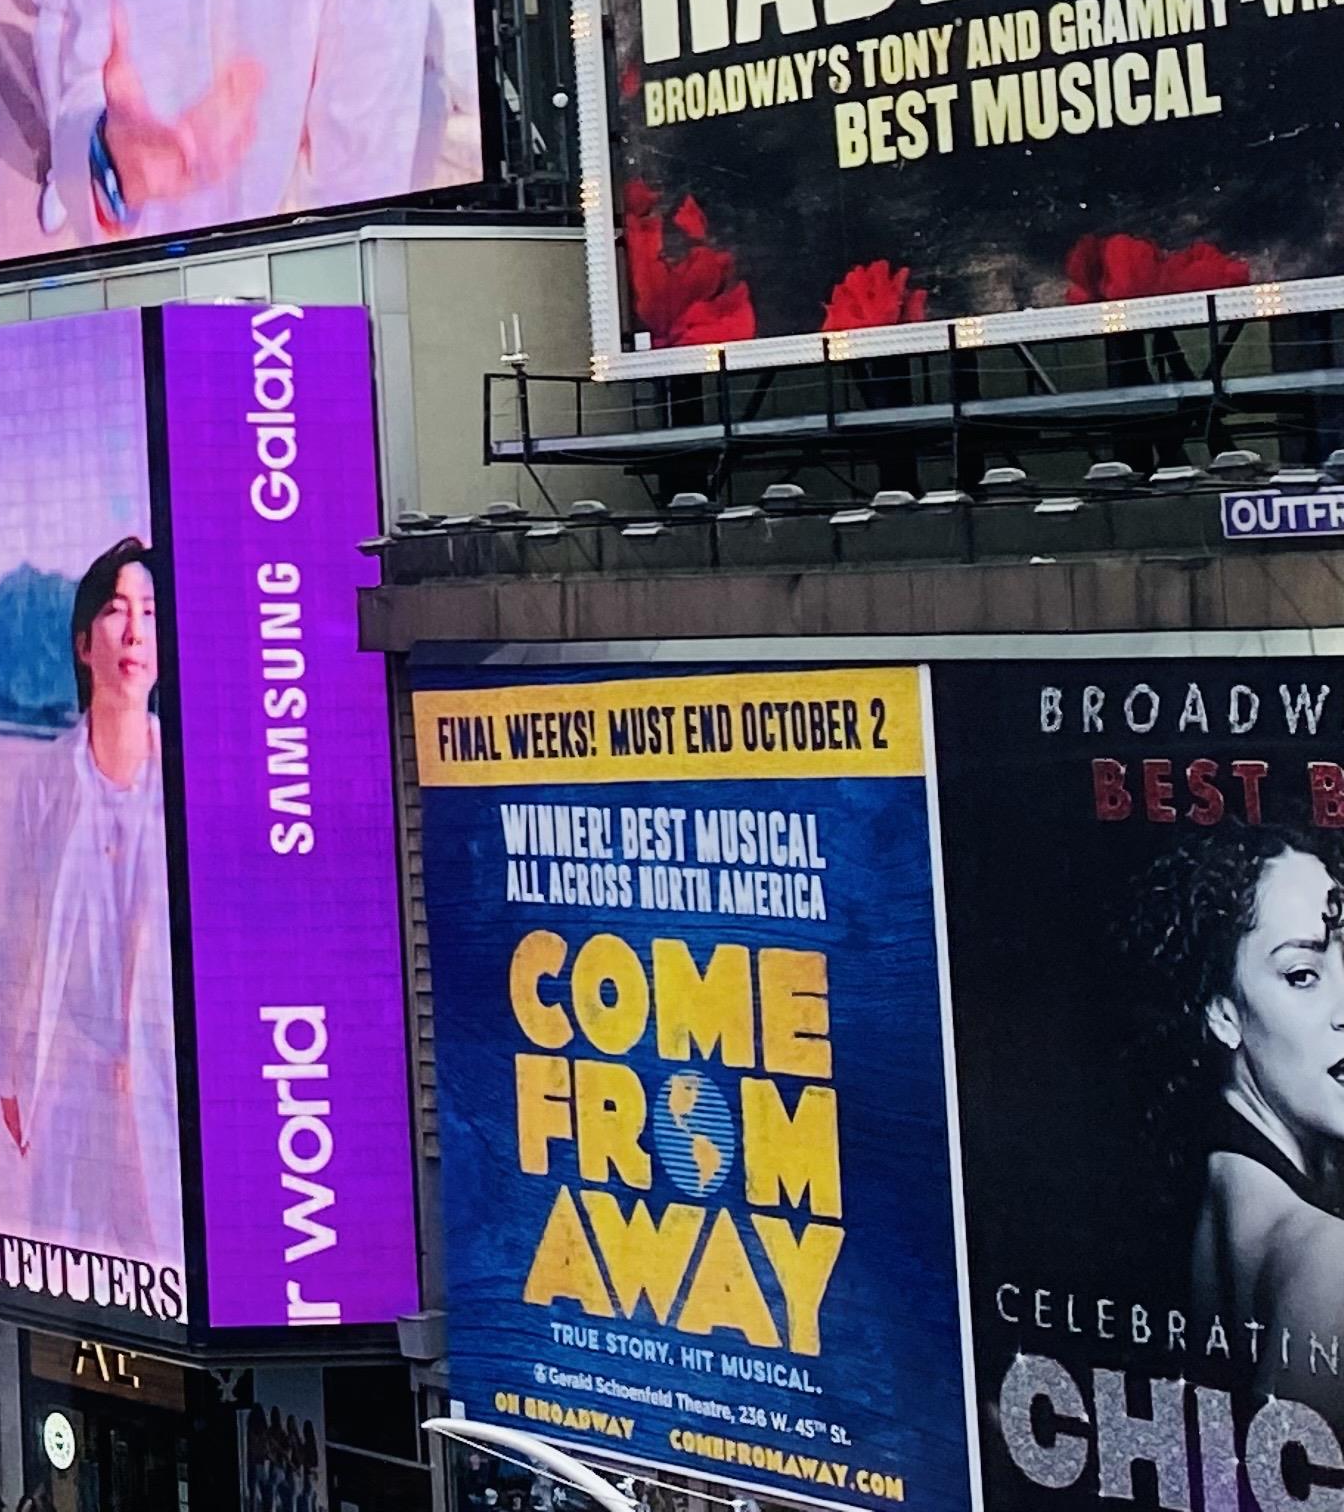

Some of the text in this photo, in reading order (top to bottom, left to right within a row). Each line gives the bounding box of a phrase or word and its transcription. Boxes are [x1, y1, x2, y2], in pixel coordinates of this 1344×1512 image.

[644, 45, 850, 128] BROADWAY'S
[967, 10, 1041, 70] AND
[835, 42, 1221, 169] BEST MUSICAL
[257, 562, 315, 855] SAMSUNG
[438, 698, 888, 762] FINAL WEEKS! MUST END OCTOBER 2
[1040, 683, 1330, 735] BROADW
[500, 804, 826, 869] WINNER! BEST MUSICAL
[1092, 758, 1268, 825] BEST
[507, 861, 827, 921] ALL ACROSS NORTH AMERICA
[509, 929, 832, 1079] COME
[261, 1003, 340, 1263] world
[523, 1185, 845, 1357] AWAY
[551, 1322, 823, 1394] TRUE STORY. HIT MUSICAL.
[996, 1283, 1338, 1376] CELEBRATIN
[550, 1367, 592, 1391] Gerald
[595, 1376, 672, 1409] Schoenfeld
[677, 1391, 735, 1424] Theatre,
[738, 1405, 767, 1429] 236
[494, 1392, 905, 1502] ON BROADWAY COMEFROMAWAY.COM
